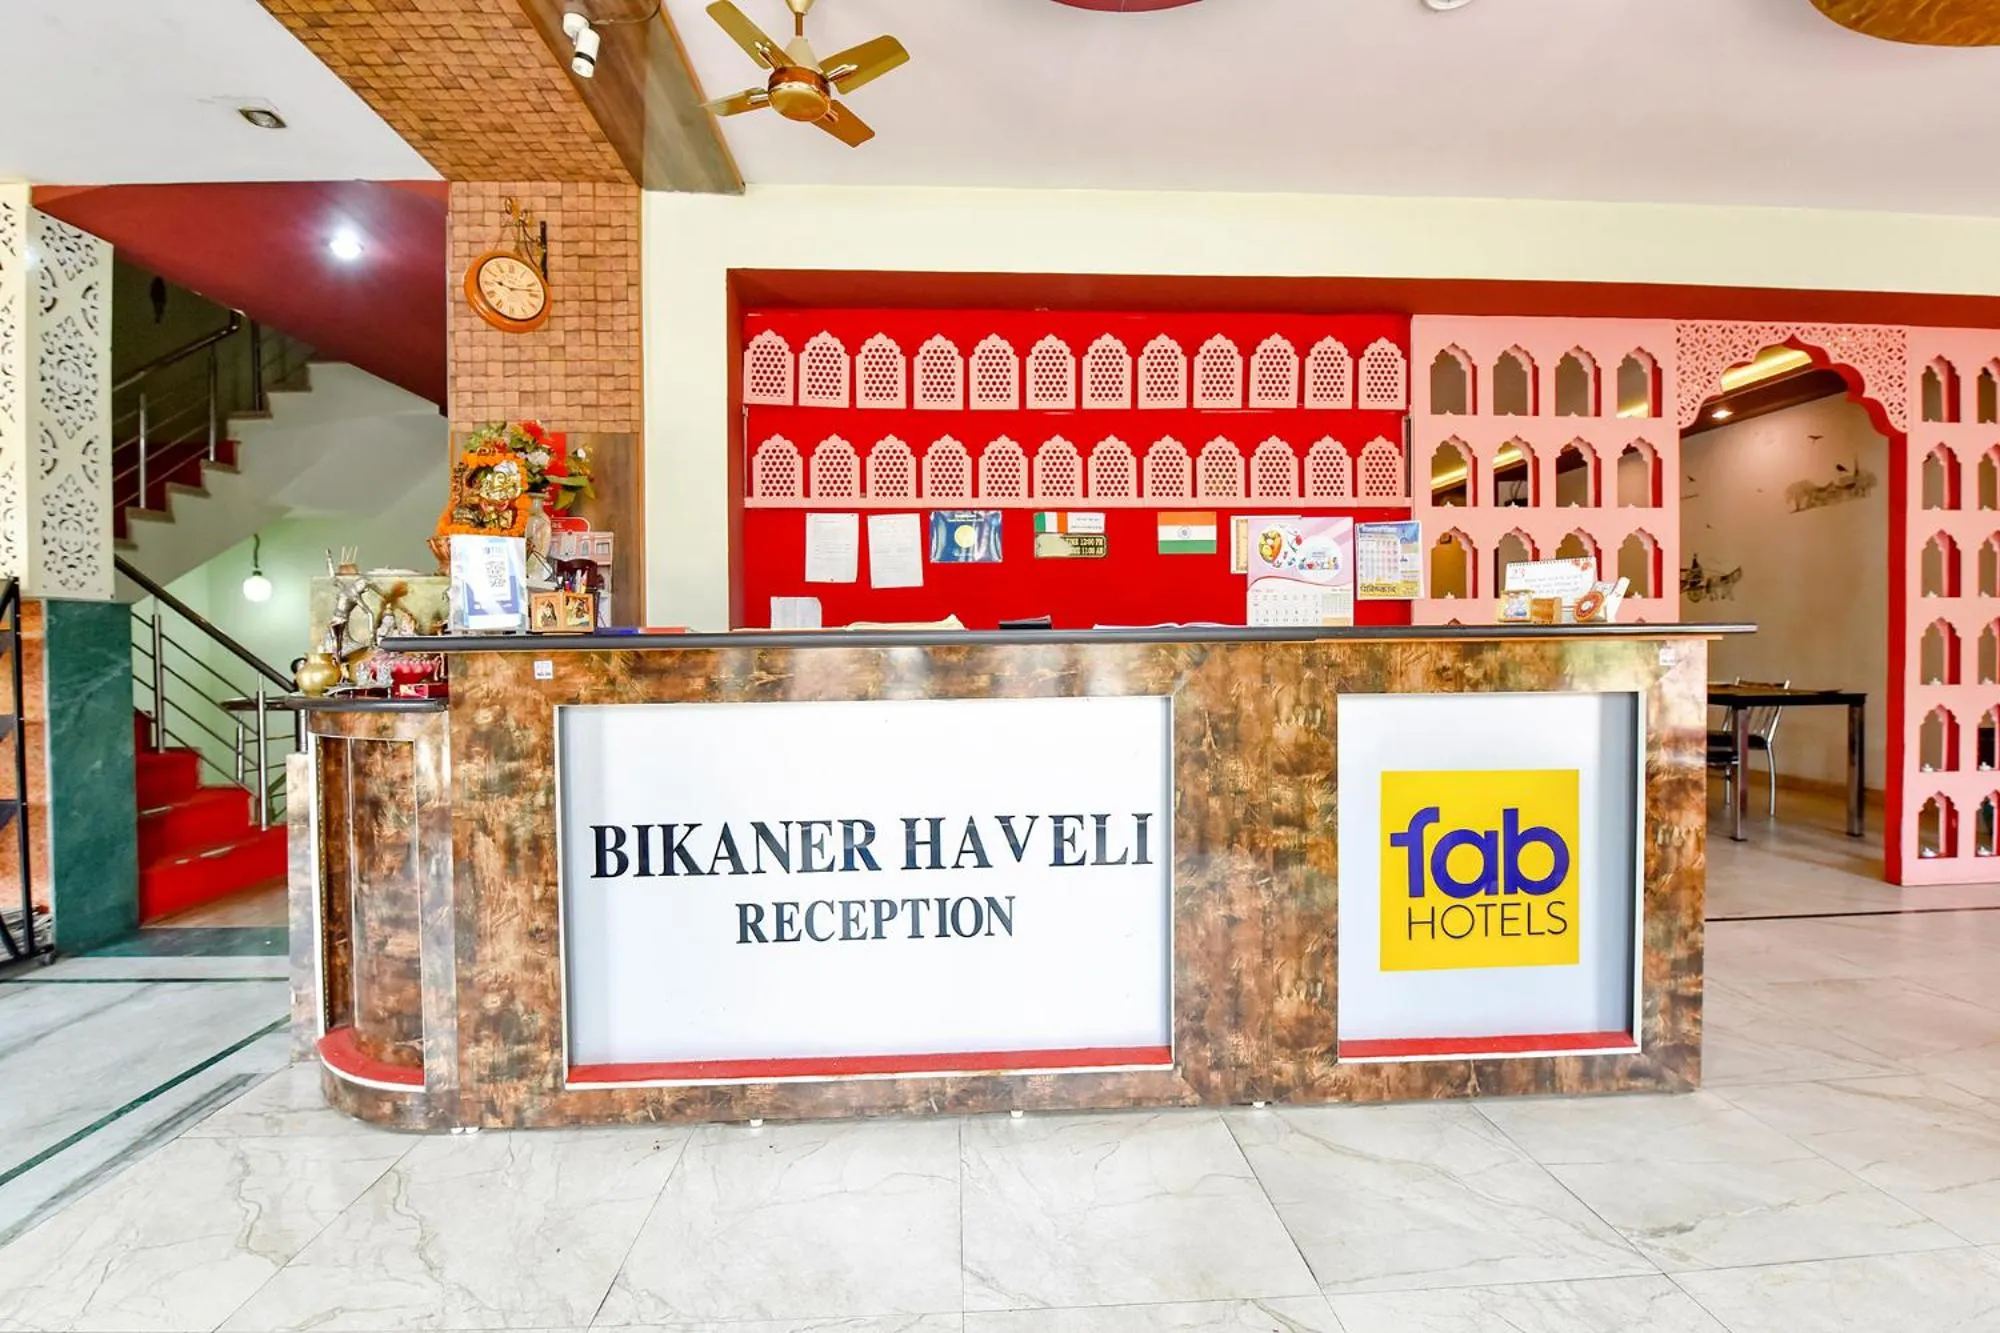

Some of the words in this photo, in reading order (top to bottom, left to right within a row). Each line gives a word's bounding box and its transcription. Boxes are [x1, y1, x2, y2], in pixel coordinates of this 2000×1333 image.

[590, 820, 881, 878] BIKANER
[900, 813, 1152, 870] HAVELI
[1390, 807, 1569, 899] fab
[736, 896, 1015, 944] RECEPTION
[1408, 901, 1567, 940] HOTELS
